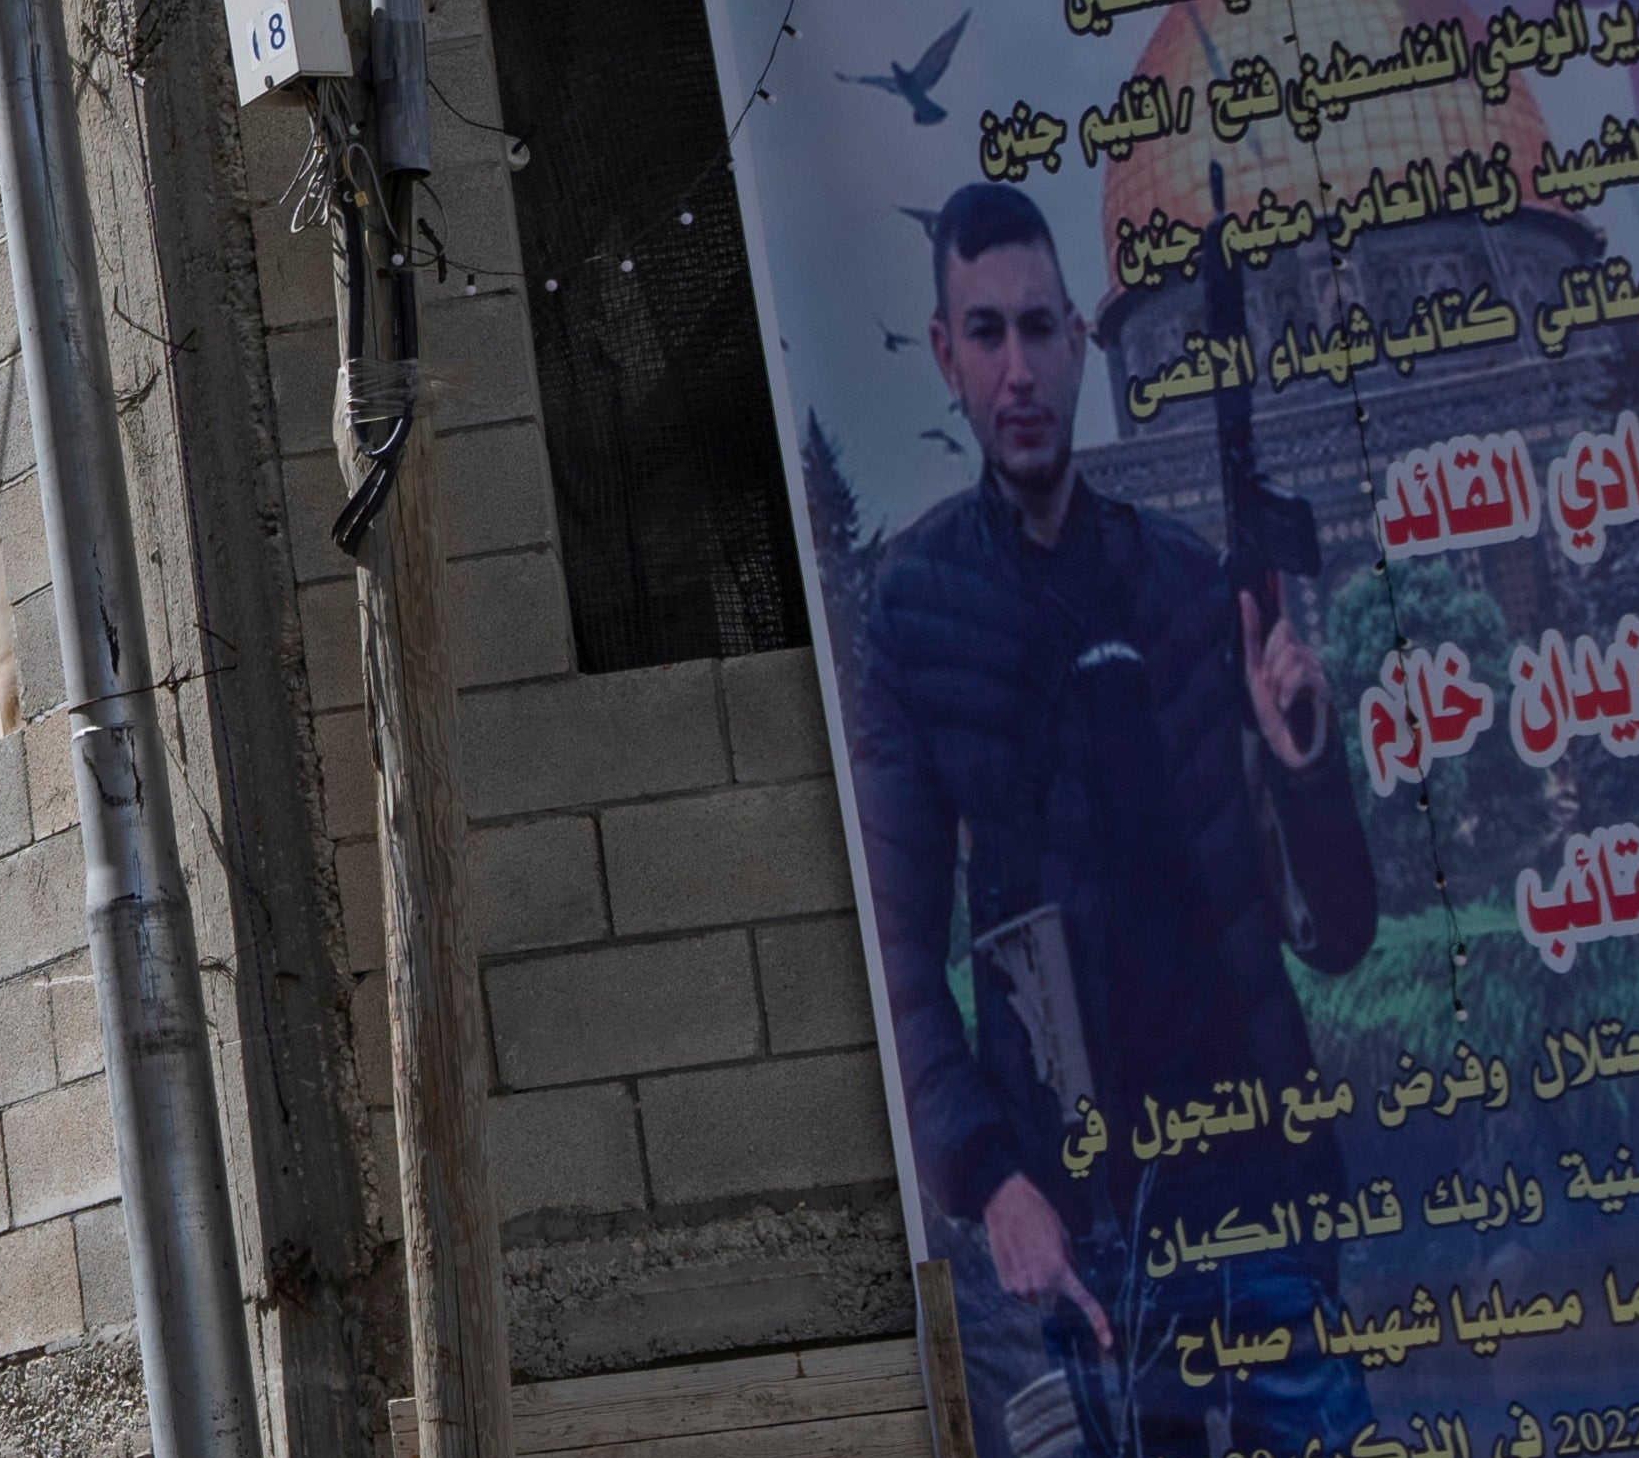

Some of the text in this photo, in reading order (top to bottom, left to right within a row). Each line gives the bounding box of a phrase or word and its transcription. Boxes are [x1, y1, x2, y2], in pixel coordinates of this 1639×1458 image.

[1209, 57, 1282, 142] فتح
[1287, 19, 1468, 141] الفلسطيني
[981, 102, 1066, 181] جنين
[1444, 143, 1518, 221] زياد
[1222, 189, 1314, 267] مخيم
[1330, 158, 1440, 246] العامر
[1119, 209, 1203, 284] جنين
[1269, 305, 1381, 391] شهداء
[1382, 287, 1518, 378] كتائب
[1127, 332, 1255, 418] الاقصى
[1383, 444, 1533, 547] القائد
[1370, 653, 1486, 784] خازم
[1131, 1077, 1269, 1160] التجول
[1280, 1068, 1355, 1144] منع
[1377, 1042, 1510, 1127] وفرض
[1062, 1096, 1109, 1178] في
[1145, 1198, 1301, 1279] الكيان
[1308, 1175, 1404, 1243] قادة
[1422, 1164, 1543, 1234] واربك
[1174, 1310, 1292, 1389] صباح
[1310, 1290, 1442, 1370] شهيدا
[1448, 1283, 1583, 1353] مصليا
